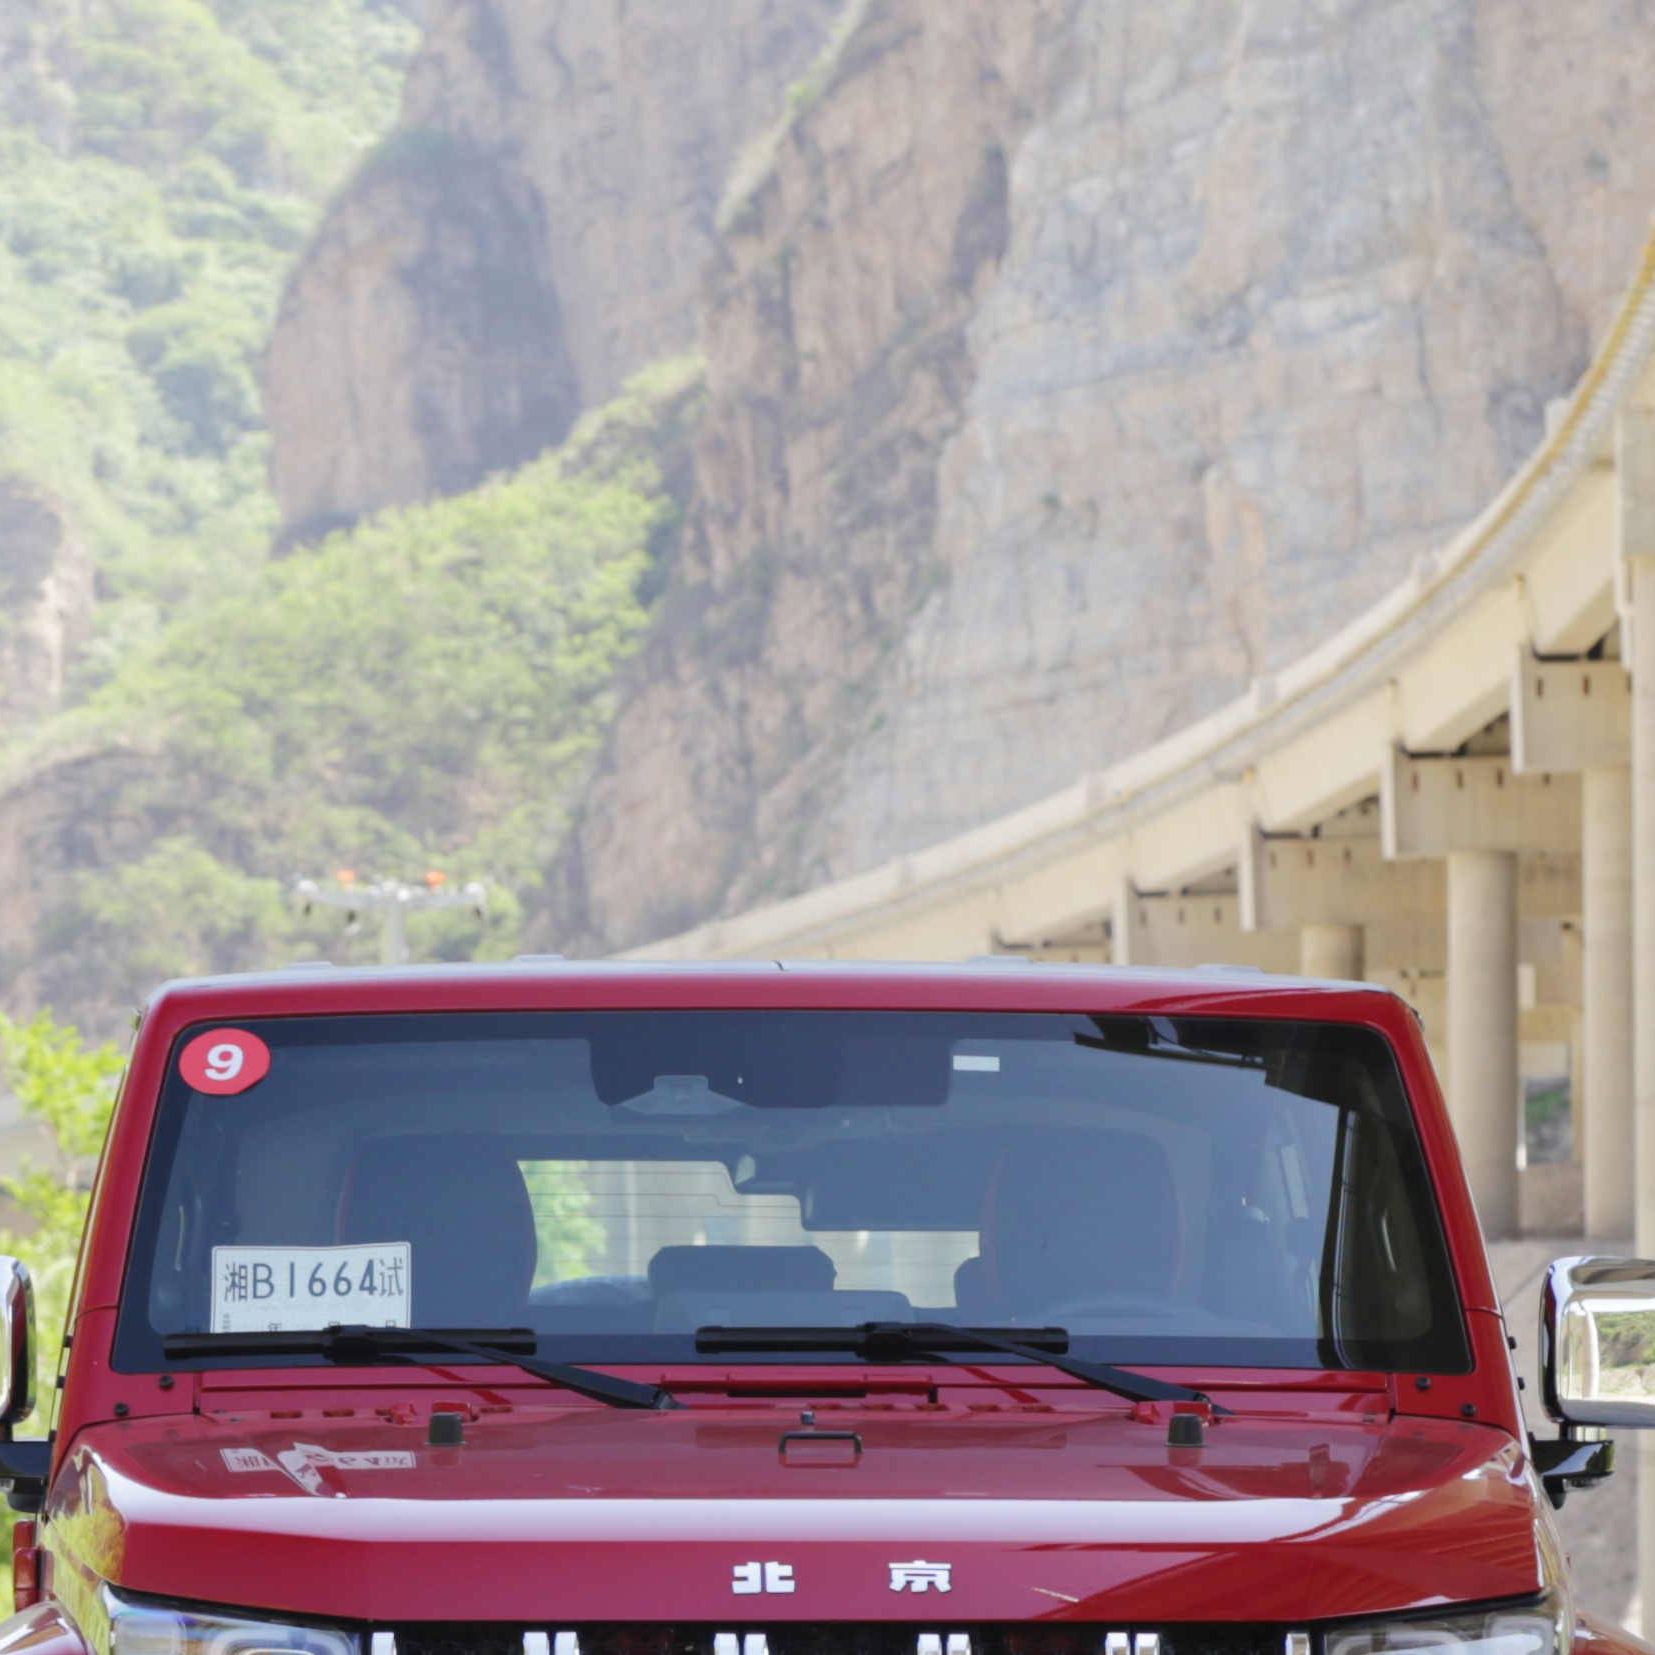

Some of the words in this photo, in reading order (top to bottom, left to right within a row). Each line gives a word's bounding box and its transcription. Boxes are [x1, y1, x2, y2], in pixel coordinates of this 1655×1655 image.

[205, 1044, 243, 1080] 9
[224, 1257, 404, 1303] 湘B1664试
[732, 1560, 952, 1594] 北京
